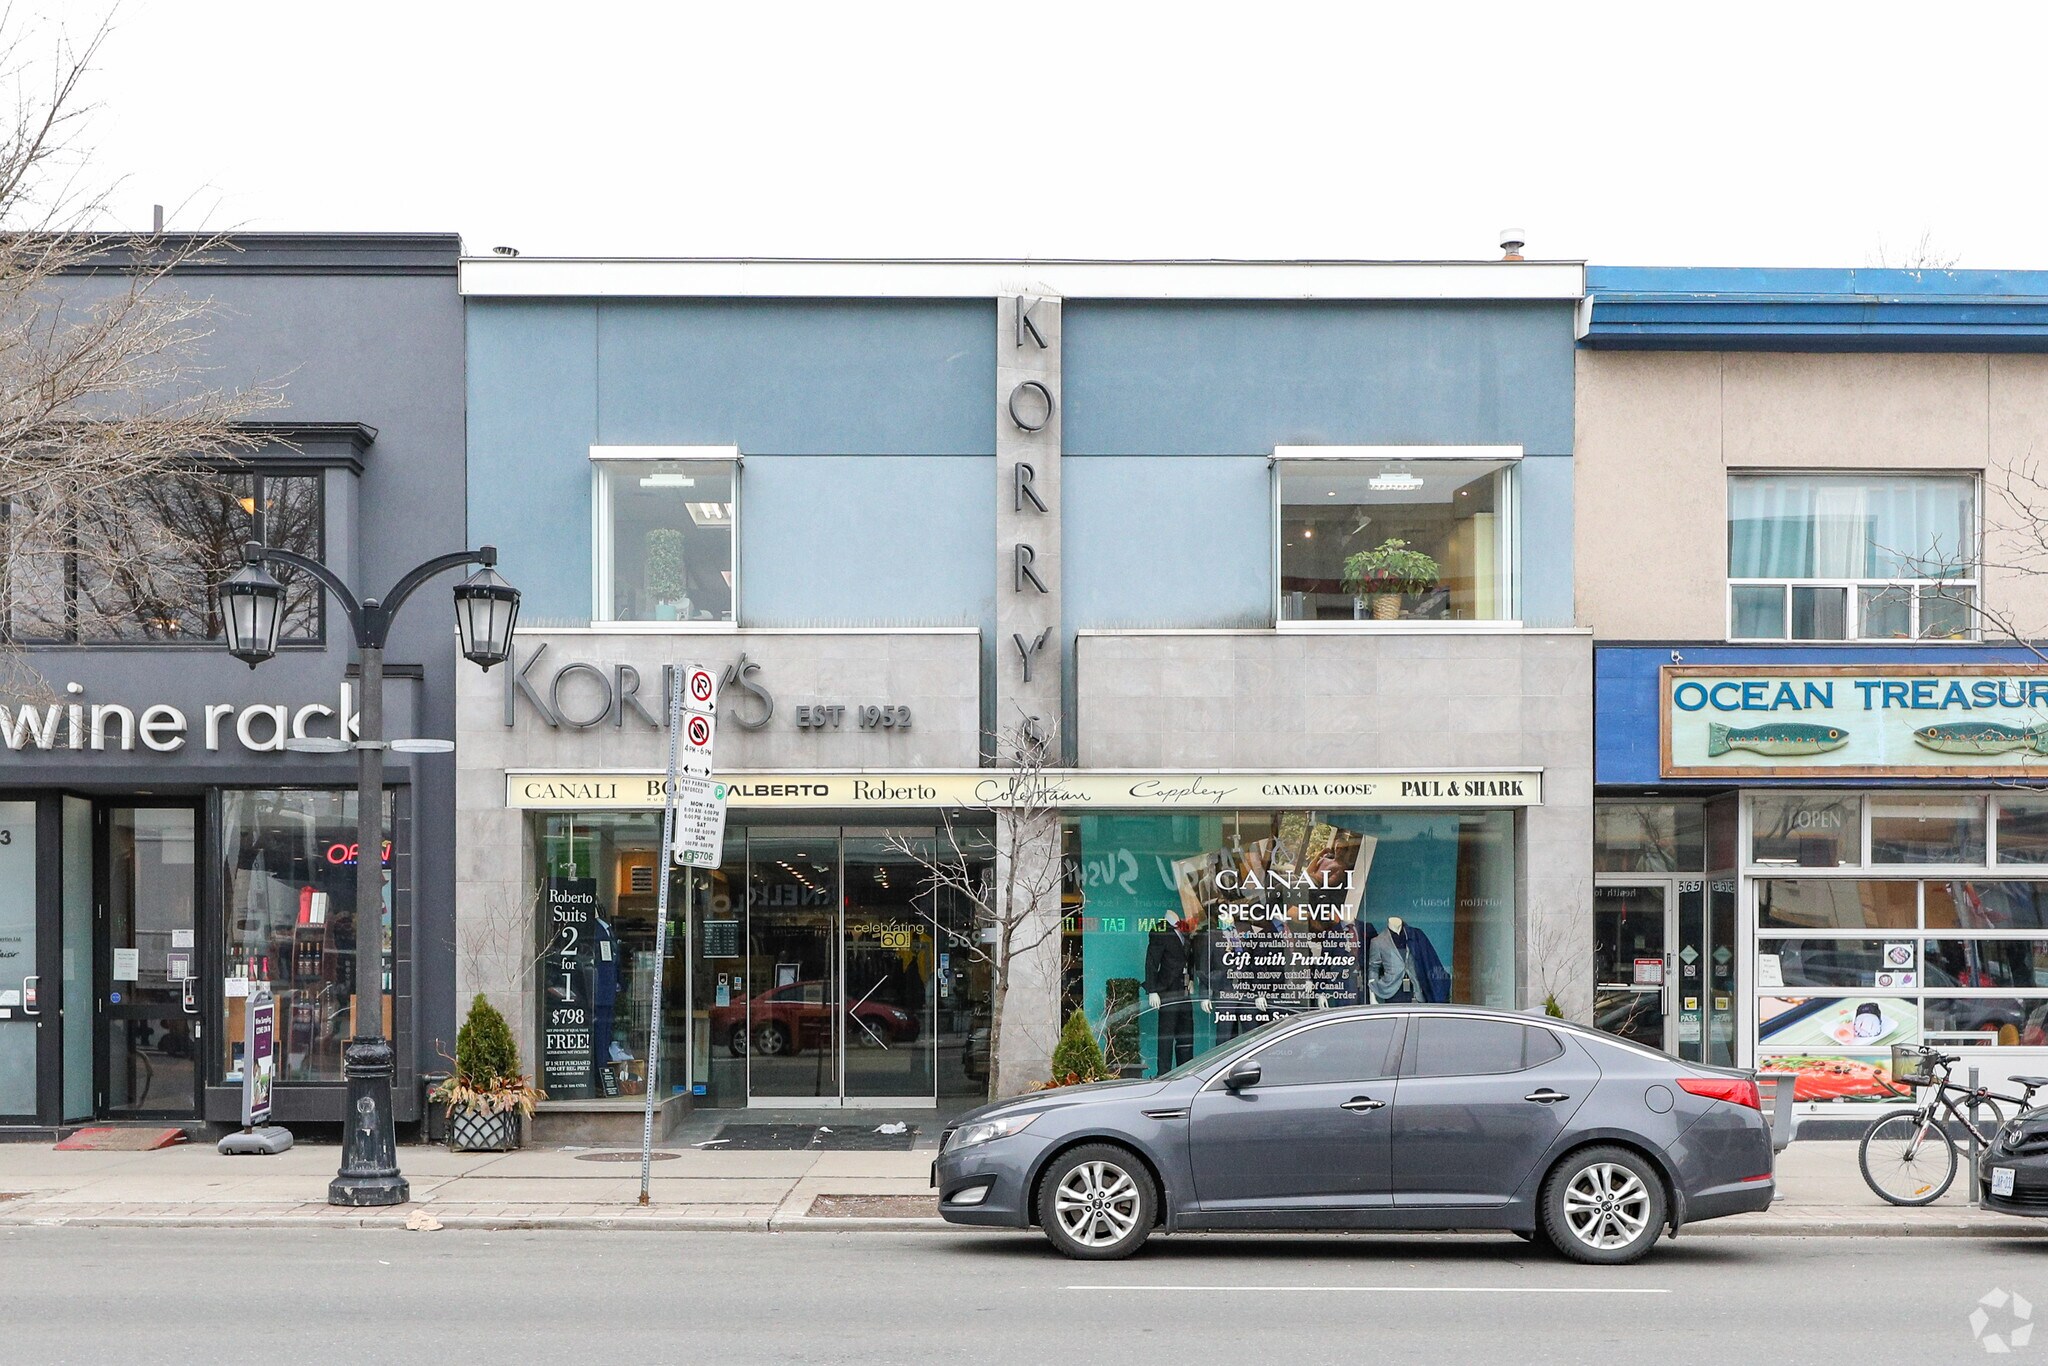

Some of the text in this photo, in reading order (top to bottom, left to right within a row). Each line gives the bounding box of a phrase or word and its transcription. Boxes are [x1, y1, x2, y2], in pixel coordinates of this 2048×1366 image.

[1674, 681, 1833, 711] OCEAN
[0, 682, 359, 752] wine rack
[796, 705, 912, 728] EST 1952
[700, 747, 704, 755] 6
[525, 783, 617, 799] CANALI
[682, 786, 703, 794] ENFORCED
[727, 785, 829, 797] ALBERTO
[853, 780, 936, 800] Roberto
[1129, 776, 1238, 804] Coppley
[1262, 784, 1319, 796] CANADA
[1401, 781, 1524, 797] PAUL & SHARK
[1799, 811, 1840, 828] OPEN
[327, 843, 391, 864] OPN
[694, 850, 714, 861] 5706
[1215, 870, 1355, 890] CANALI
[1679, 881, 1700, 892] 565
[549, 889, 593, 904] Roberto
[553, 906, 587, 923] Suits
[1218, 903, 1353, 921] SPECIAL EVENT
[854, 922, 925, 935] celebrating
[1247, 931, 1266, 939] from
[1273, 931, 1293, 939] wide
[1294, 933, 1316, 941] range
[1317, 931, 1326, 939] of
[1327, 931, 1354, 939] fabrics
[560, 926, 578, 956] 2
[882, 933, 906, 947] 60
[1215, 940, 1258, 949] exclusively
[1259, 940, 1294, 948] available
[1322, 940, 1337, 948] this
[561, 957, 577, 970] for
[1222, 952, 1355, 970] Gift with Purchase
[1227, 970, 1254, 979] from
[1284, 970, 1311, 979] until
[1313, 970, 1339, 982] May
[1342, 970, 1349, 979] 5
[561, 973, 575, 1002] 1
[1232, 982, 1250, 990] with
[1251, 984, 1271, 992] your
[1312, 982, 1319, 990] of
[1320, 982, 1344, 990] Canali
[1219, 991, 1279, 1000] Ready-to-Wear
[1281, 991, 1295, 999] and
[552, 1008, 585, 1025] $798
[1214, 1012, 1237, 1023] Join
[1681, 1014, 1697, 1022] PASS
[546, 1033, 590, 1049] FREE!
